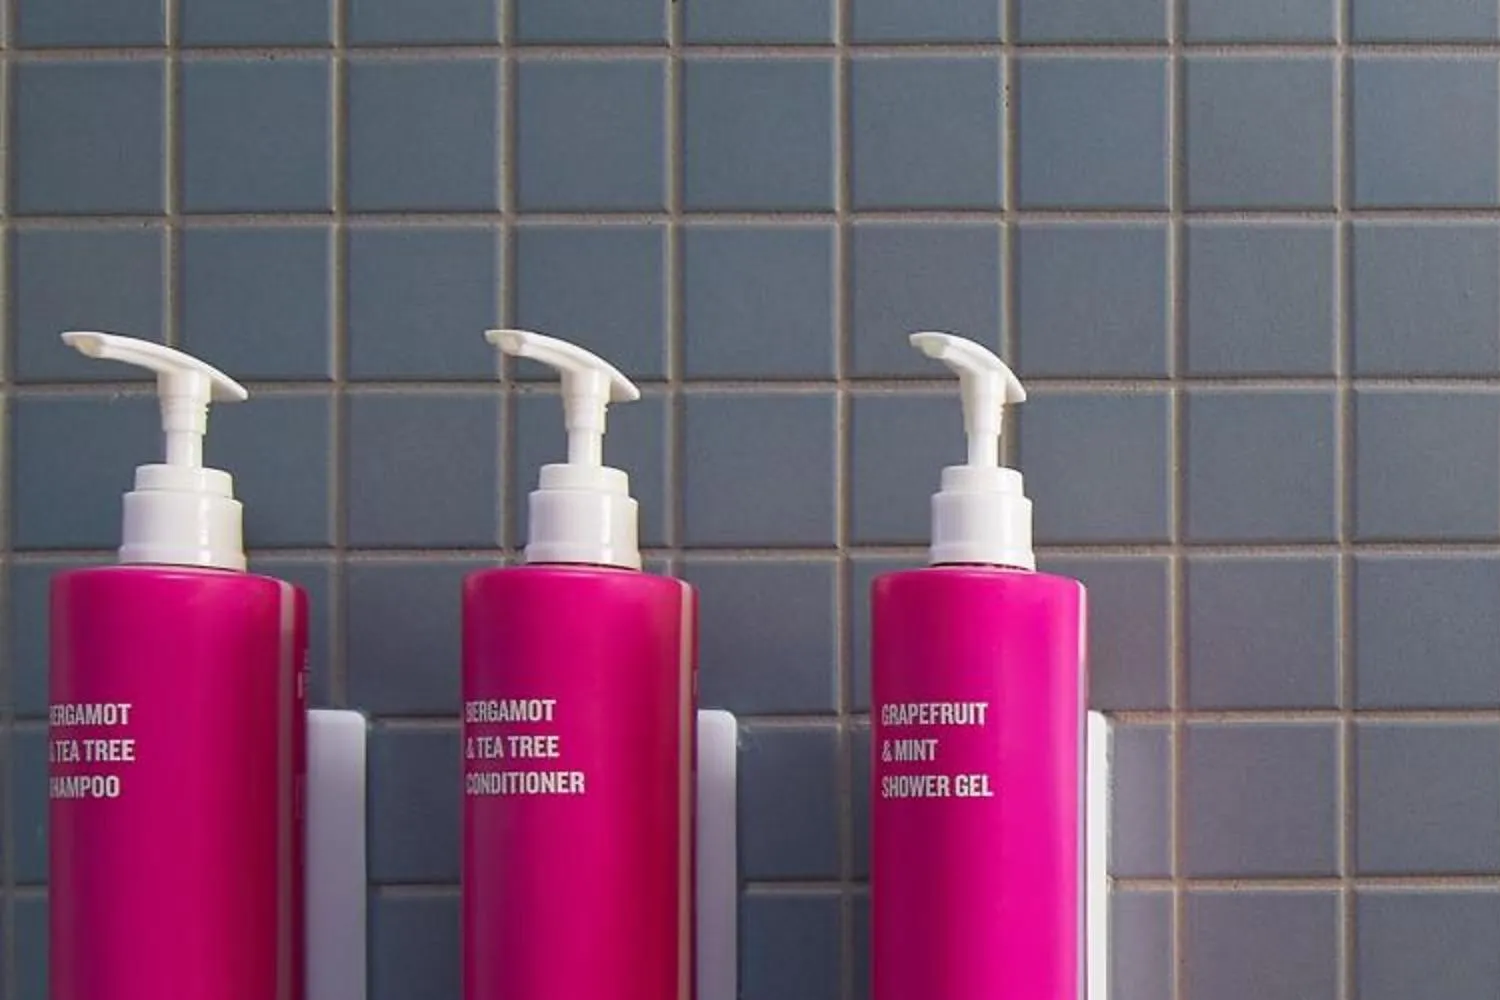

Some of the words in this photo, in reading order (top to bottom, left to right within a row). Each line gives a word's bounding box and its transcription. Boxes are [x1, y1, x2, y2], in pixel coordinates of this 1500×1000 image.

[882, 702, 989, 726] GRAPEFRUIT
[56, 739, 80, 762] TEA
[83, 738, 135, 761] TREE
[478, 736, 504, 759] TEA
[507, 735, 560, 758] TREE
[882, 740, 893, 762] &
[895, 739, 939, 761] MINT
[466, 771, 586, 795] CONDITIONER
[882, 775, 951, 798] SHOWER
[955, 774, 994, 797] GEL
